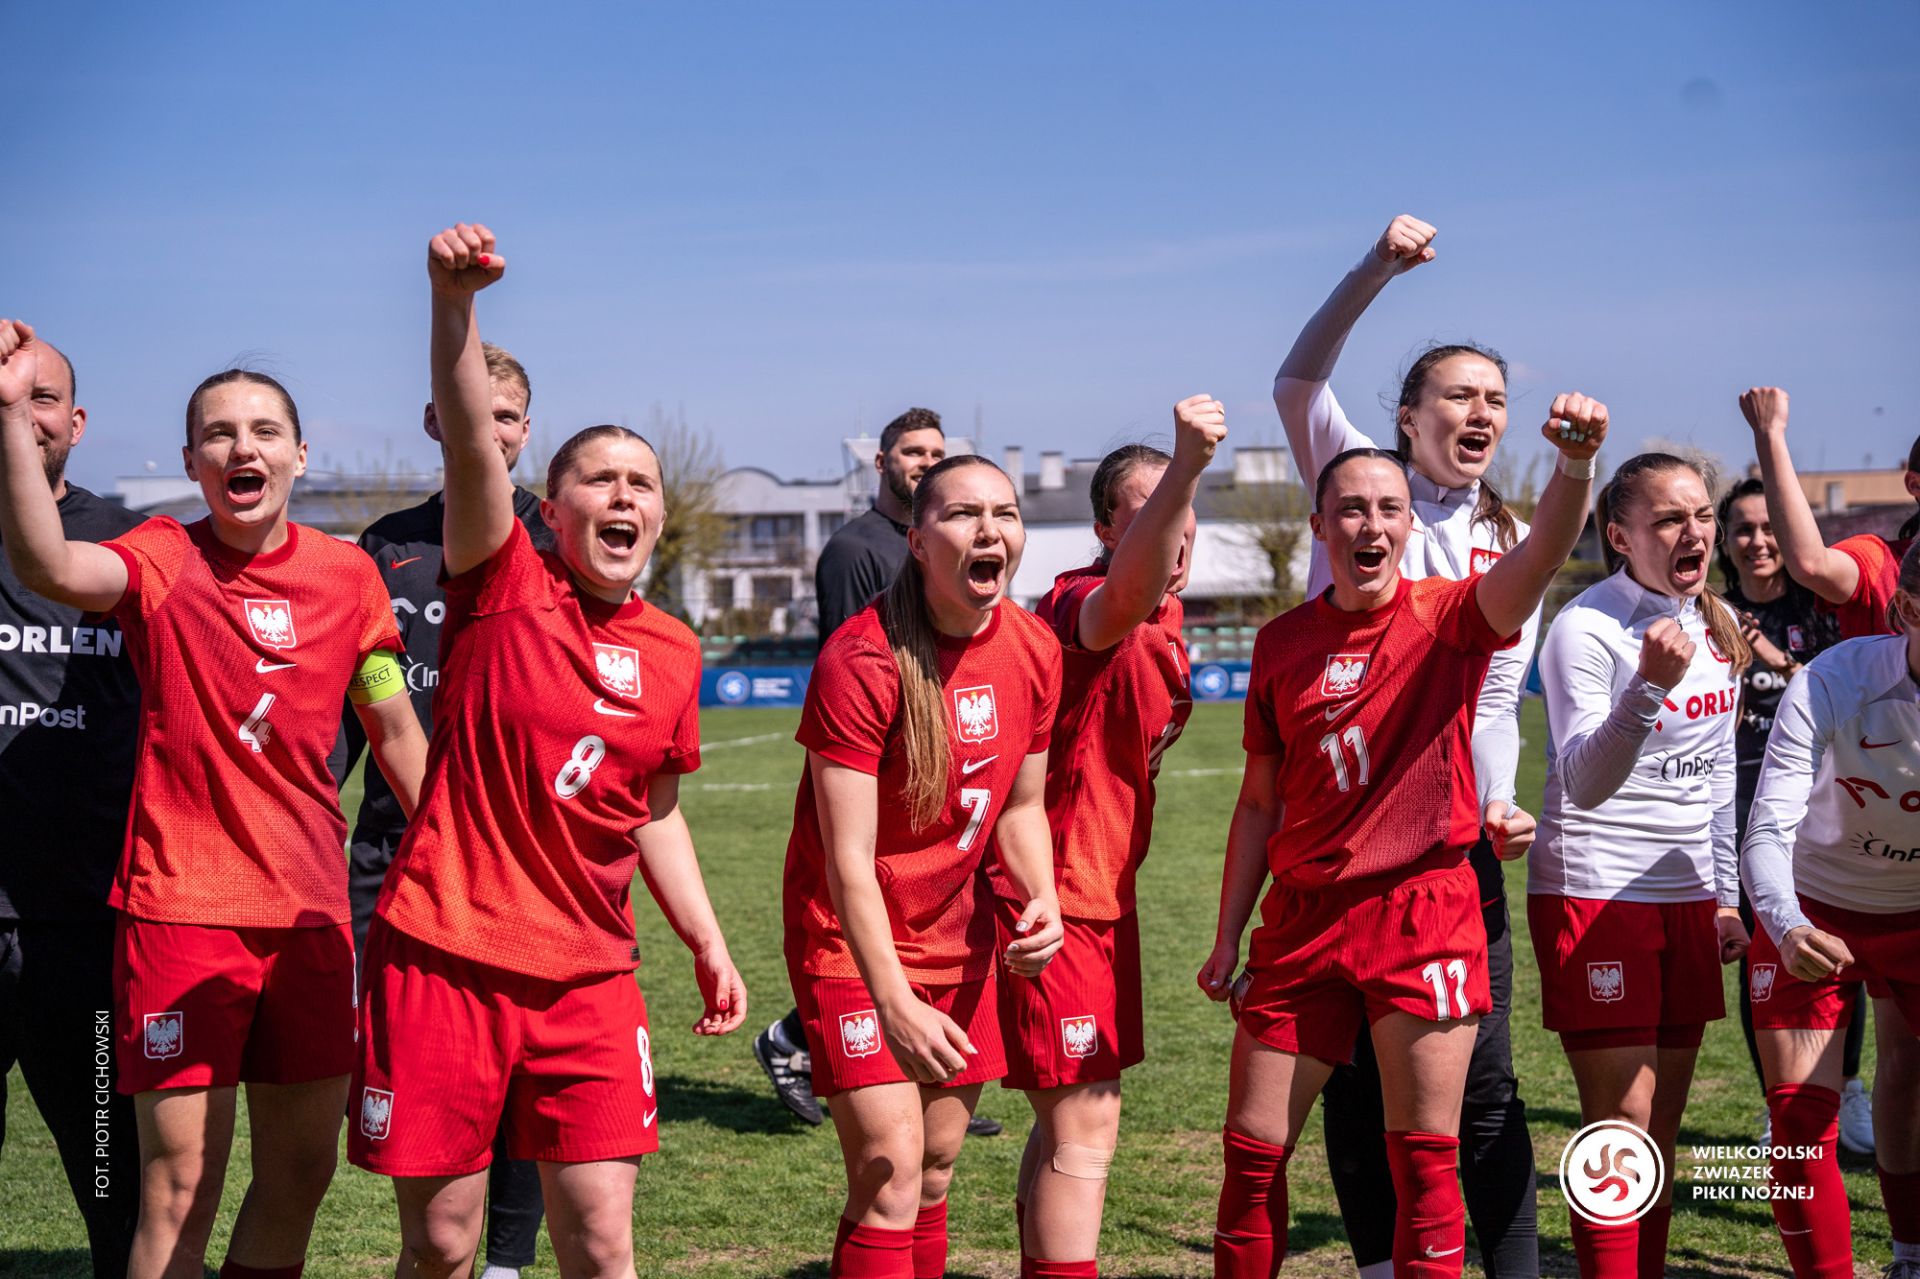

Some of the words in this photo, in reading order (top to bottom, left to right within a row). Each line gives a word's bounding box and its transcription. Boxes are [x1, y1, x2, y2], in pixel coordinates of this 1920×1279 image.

[0, 624, 122, 657] ORLEN
[352, 668, 391, 687] ESPECT
[1686, 687, 1735, 720] ORLE
[0, 701, 86, 730] nPost
[238, 692, 276, 753] 4
[555, 734, 606, 799] 8
[1320, 725, 1370, 792] 11
[1675, 753, 1717, 779] InPos
[957, 788, 991, 852] 7
[1422, 959, 1470, 1021] 11
[637, 1025, 653, 1097] 8
